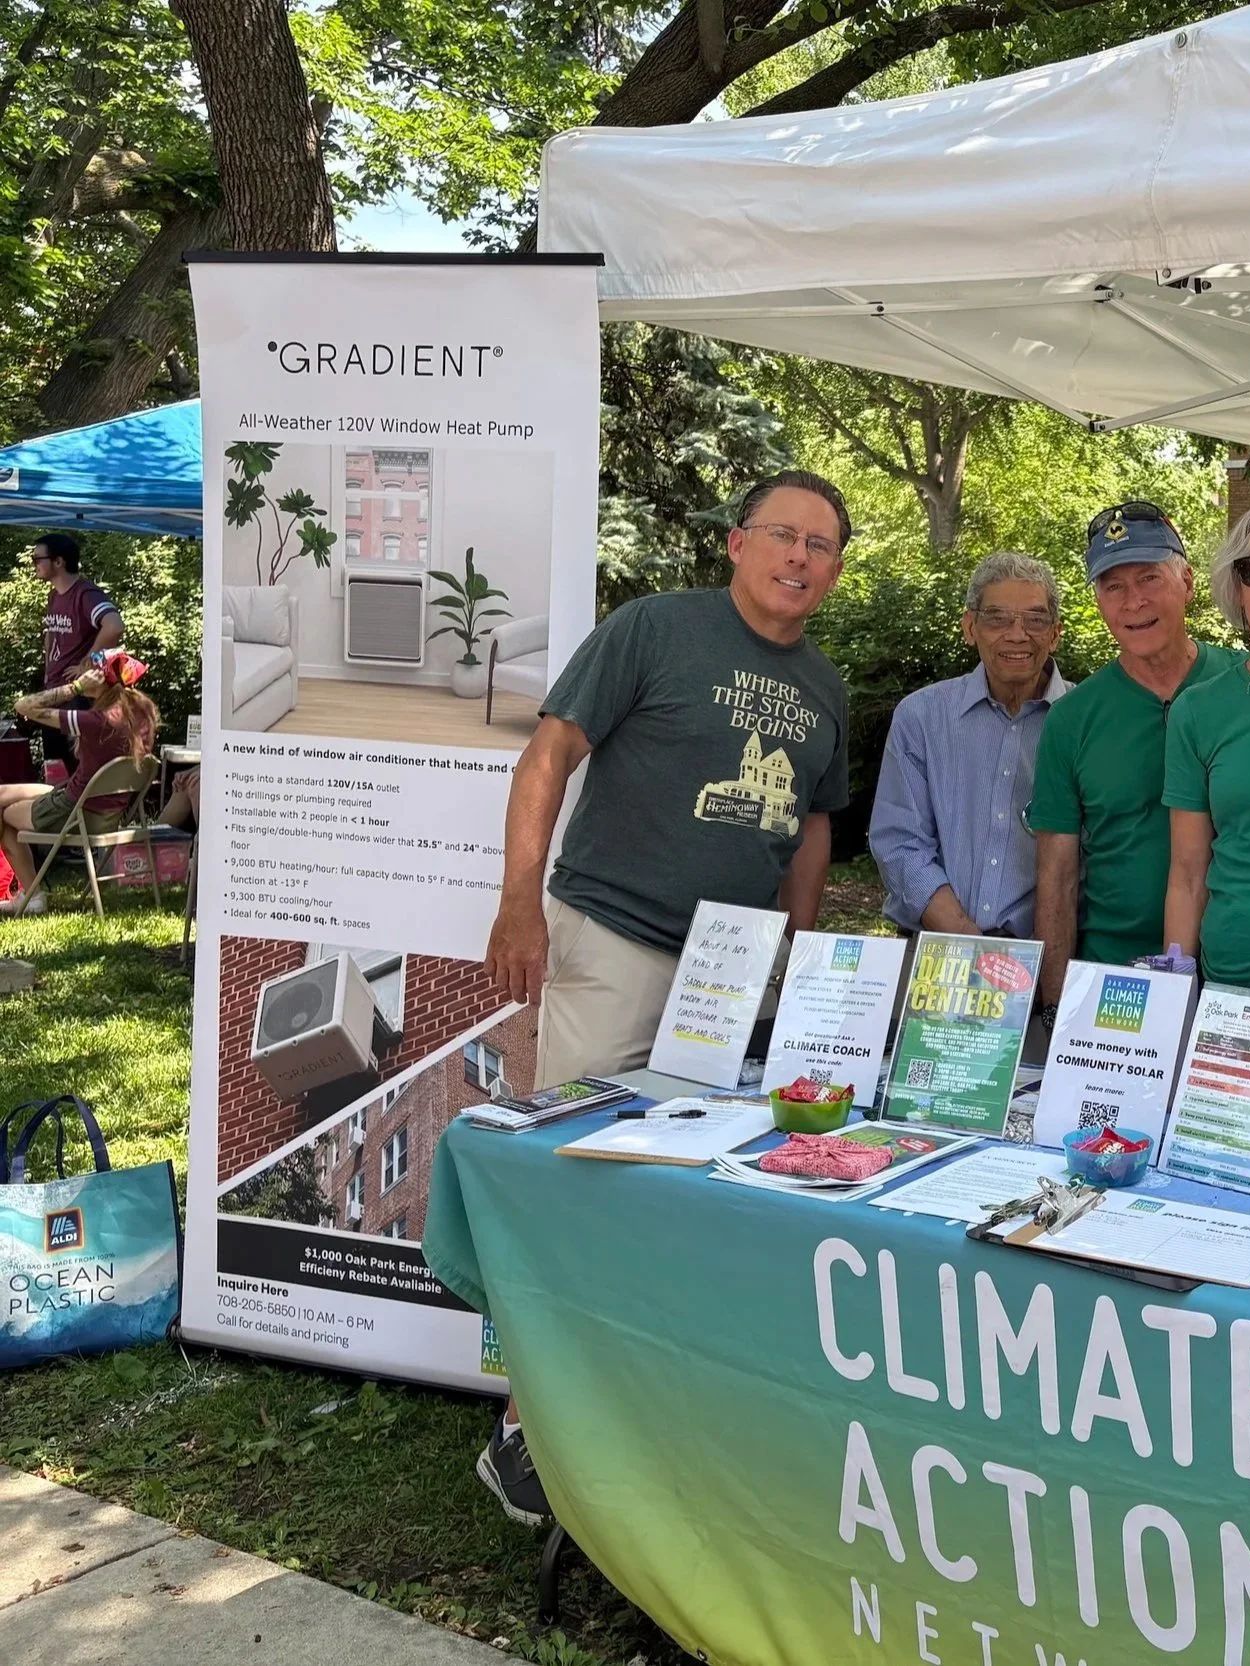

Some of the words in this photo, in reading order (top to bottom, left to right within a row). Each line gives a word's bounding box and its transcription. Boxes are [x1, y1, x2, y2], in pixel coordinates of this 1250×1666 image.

[238, 412, 332, 431] All-Weather
[337, 416, 375, 432] 120V
[380, 417, 441, 434] Window
[446, 419, 482, 436] Heat
[488, 420, 534, 440] Pump
[733, 670, 801, 705] WHERE
[712, 685, 755, 710] THE
[759, 697, 820, 728] STORY
[730, 709, 807, 743] BEGINS
[222, 742, 230, 752] A
[232, 744, 256, 754] new
[259, 744, 284, 756] kind
[288, 746, 300, 757] of
[302, 747, 346, 760] window
[348, 751, 364, 762] air
[365, 753, 426, 766] conditioner
[428, 757, 451, 769] that
[453, 759, 484, 772] heats
[486, 762, 508, 773] and
[231, 772, 254, 784] Plugs
[256, 773, 274, 784] into
[276, 776, 283, 784] a
[285, 776, 324, 787] standard
[327, 778, 374, 791] 120V/15A
[375, 783, 400, 794] outlet
[231, 788, 243, 799] No
[244, 790, 281, 803] drillings
[282, 793, 293, 802] or
[295, 793, 336, 807] plumbing
[337, 798, 372, 808] required
[230, 822, 246, 833] Fits
[248, 824, 333, 841] single/double-hung
[335, 831, 371, 843] windows
[372, 835, 396, 845] wider
[397, 836, 415, 847] that
[444, 842, 460, 852] and
[481, 844, 506, 856] abov
[230, 839, 251, 850] floor
[230, 856, 256, 868] 9,000
[258, 859, 277, 869] BTU
[340, 865, 354, 876] full
[355, 868, 390, 881] capacity
[391, 871, 414, 882] down
[416, 873, 425, 883] to
[439, 875, 445, 885] F
[447, 878, 463, 887] and
[230, 907, 252, 918] Ideal
[254, 909, 268, 919] for
[269, 911, 311, 923] 400-600
[313, 916, 327, 926] sq.
[329, 916, 340, 926] ft.
[342, 919, 370, 929] spaces
[833, 954, 858, 964] ACTION
[836, 946, 859, 956] CLIMATE
[944, 945, 963, 956] TALK
[916, 956, 970, 985] DATA
[1104, 988, 1144, 1005] CLIMATE
[1107, 980, 1122, 989] OAK
[1127, 982, 1146, 990] PARK
[910, 982, 1008, 1019] CENTERS
[1101, 1004, 1142, 1019] ACTION
[1099, 1017, 1139, 1028] NETWORK
[1210, 1008, 1223, 1017] Oak
[1223, 1010, 1238, 1019] Park
[783, 1040, 830, 1054] CLIMATE
[832, 1045, 871, 1058] COACH
[1069, 1038, 1094, 1049] save
[1096, 1042, 1132, 1056] money
[1135, 1047, 1158, 1059] with
[1056, 1054, 1124, 1073] COMMUNITY
[1126, 1065, 1164, 1080] SOLAR
[1085, 1083, 1103, 1093] learn
[51, 1232, 77, 1245] ALDI
[304, 1246, 342, 1262] $1,000
[344, 1252, 367, 1268] Oak
[369, 1256, 396, 1270] Park
[9, 1262, 114, 1292] OCEAN
[217, 1275, 259, 1293] Inquire
[260, 1281, 289, 1298] Here
[299, 1261, 346, 1281] Efficieny
[348, 1269, 388, 1285] Rebate
[389, 1276, 442, 1294] Avaliable
[9, 1286, 116, 1316] PLASTIC
[216, 1312, 237, 1327] Call
[238, 1315, 254, 1330] for
[254, 1319, 289, 1336] details
[290, 1327, 311, 1340] and
[312, 1330, 349, 1349] pricing
[302, 1308, 315, 1321] 10
[315, 1310, 335, 1325] AM
[346, 1315, 354, 1328] 6
[356, 1316, 374, 1331] PM
